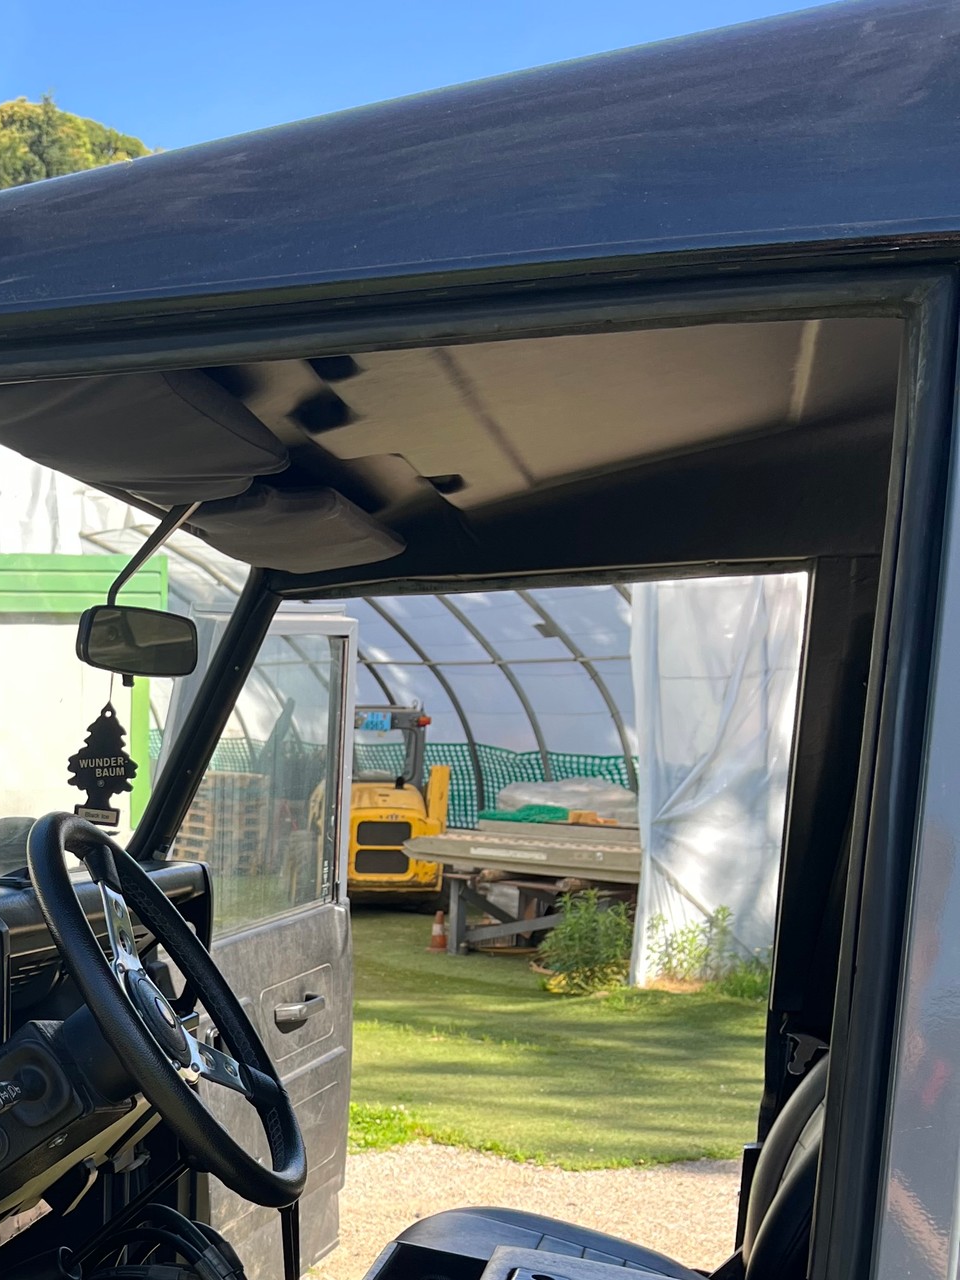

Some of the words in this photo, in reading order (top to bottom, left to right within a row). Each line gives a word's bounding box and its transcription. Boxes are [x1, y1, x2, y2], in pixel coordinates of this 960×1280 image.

[79, 757, 128, 768] WUNDER-
[95, 767, 125, 778] BAUM
[84, 811, 100, 819] Black
